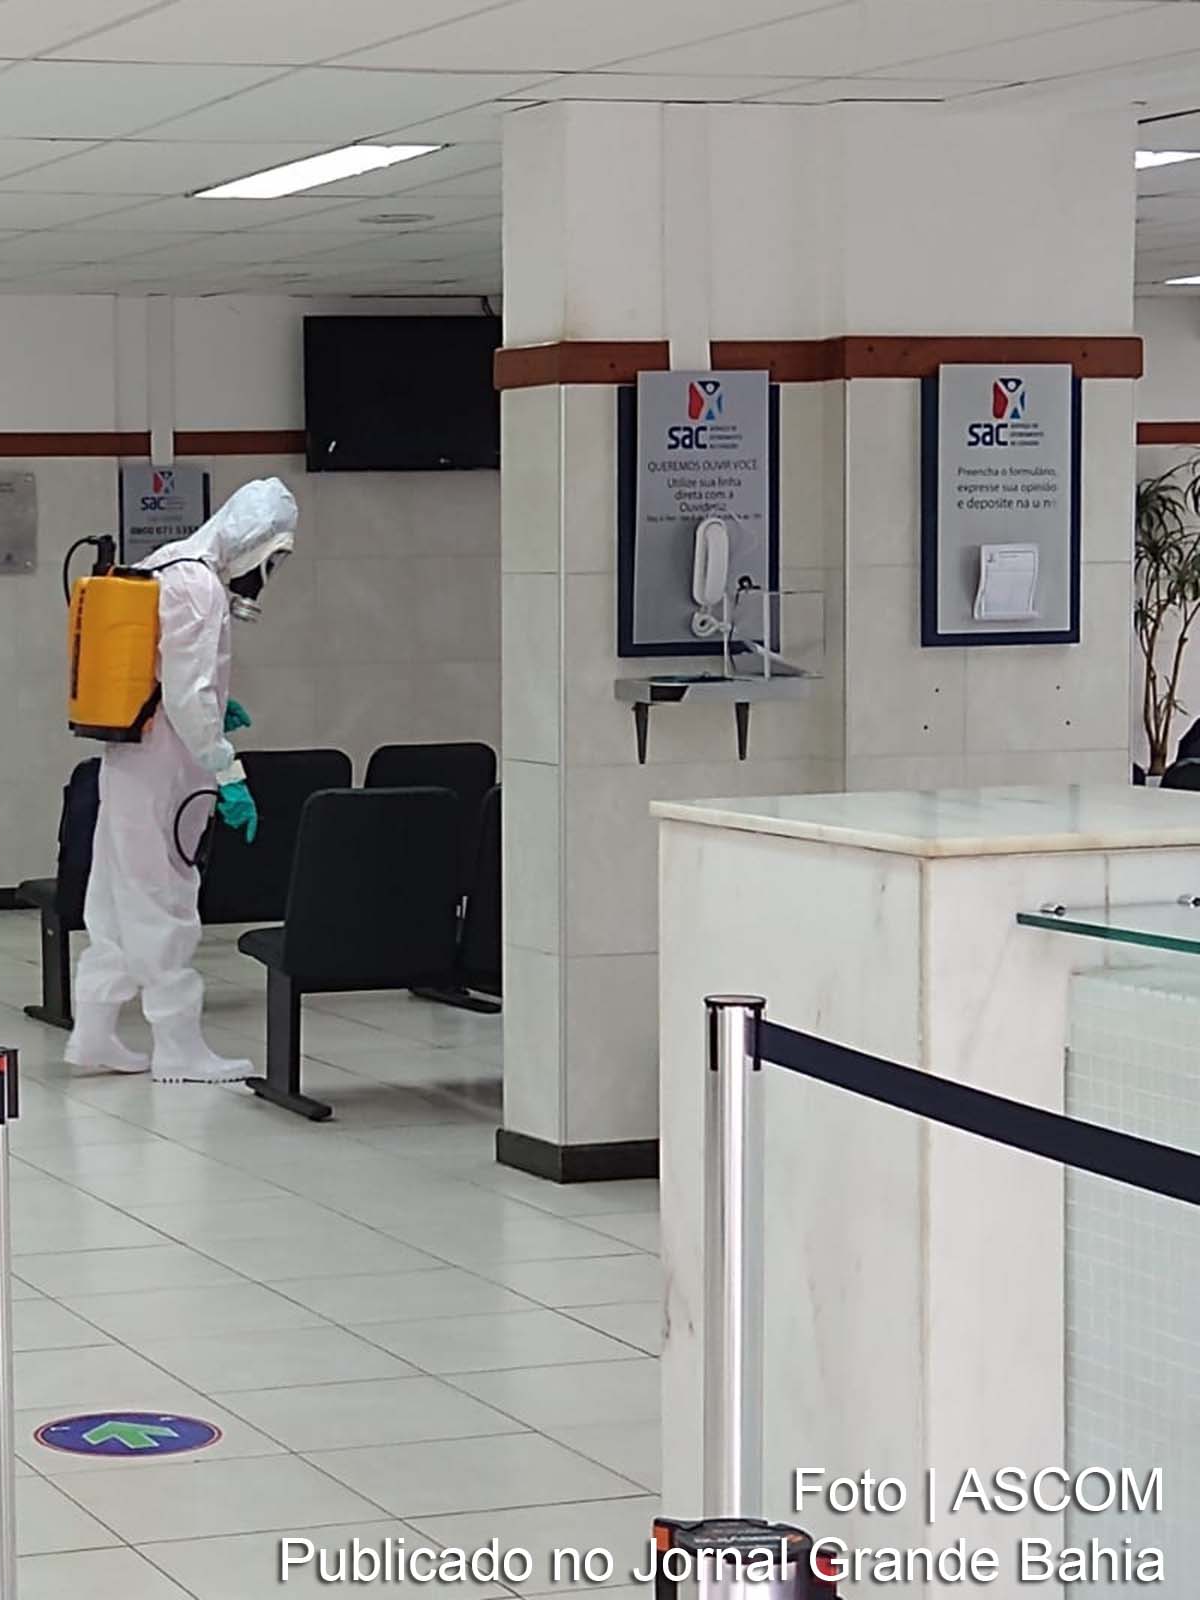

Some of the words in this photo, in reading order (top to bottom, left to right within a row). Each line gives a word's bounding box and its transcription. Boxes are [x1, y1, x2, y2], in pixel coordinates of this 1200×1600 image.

[666, 426, 707, 449] sac
[967, 423, 1008, 446] sac
[647, 461, 700, 472] QUEREMOS
[702, 460, 731, 471] OUVIR
[957, 466, 999, 476] Preencha
[699, 479, 717, 487] sua
[1002, 484, 1018, 492] sua
[674, 489, 703, 500] direta
[705, 491, 726, 499] com
[966, 497, 1013, 509] deposite
[1016, 500, 1030, 509] na
